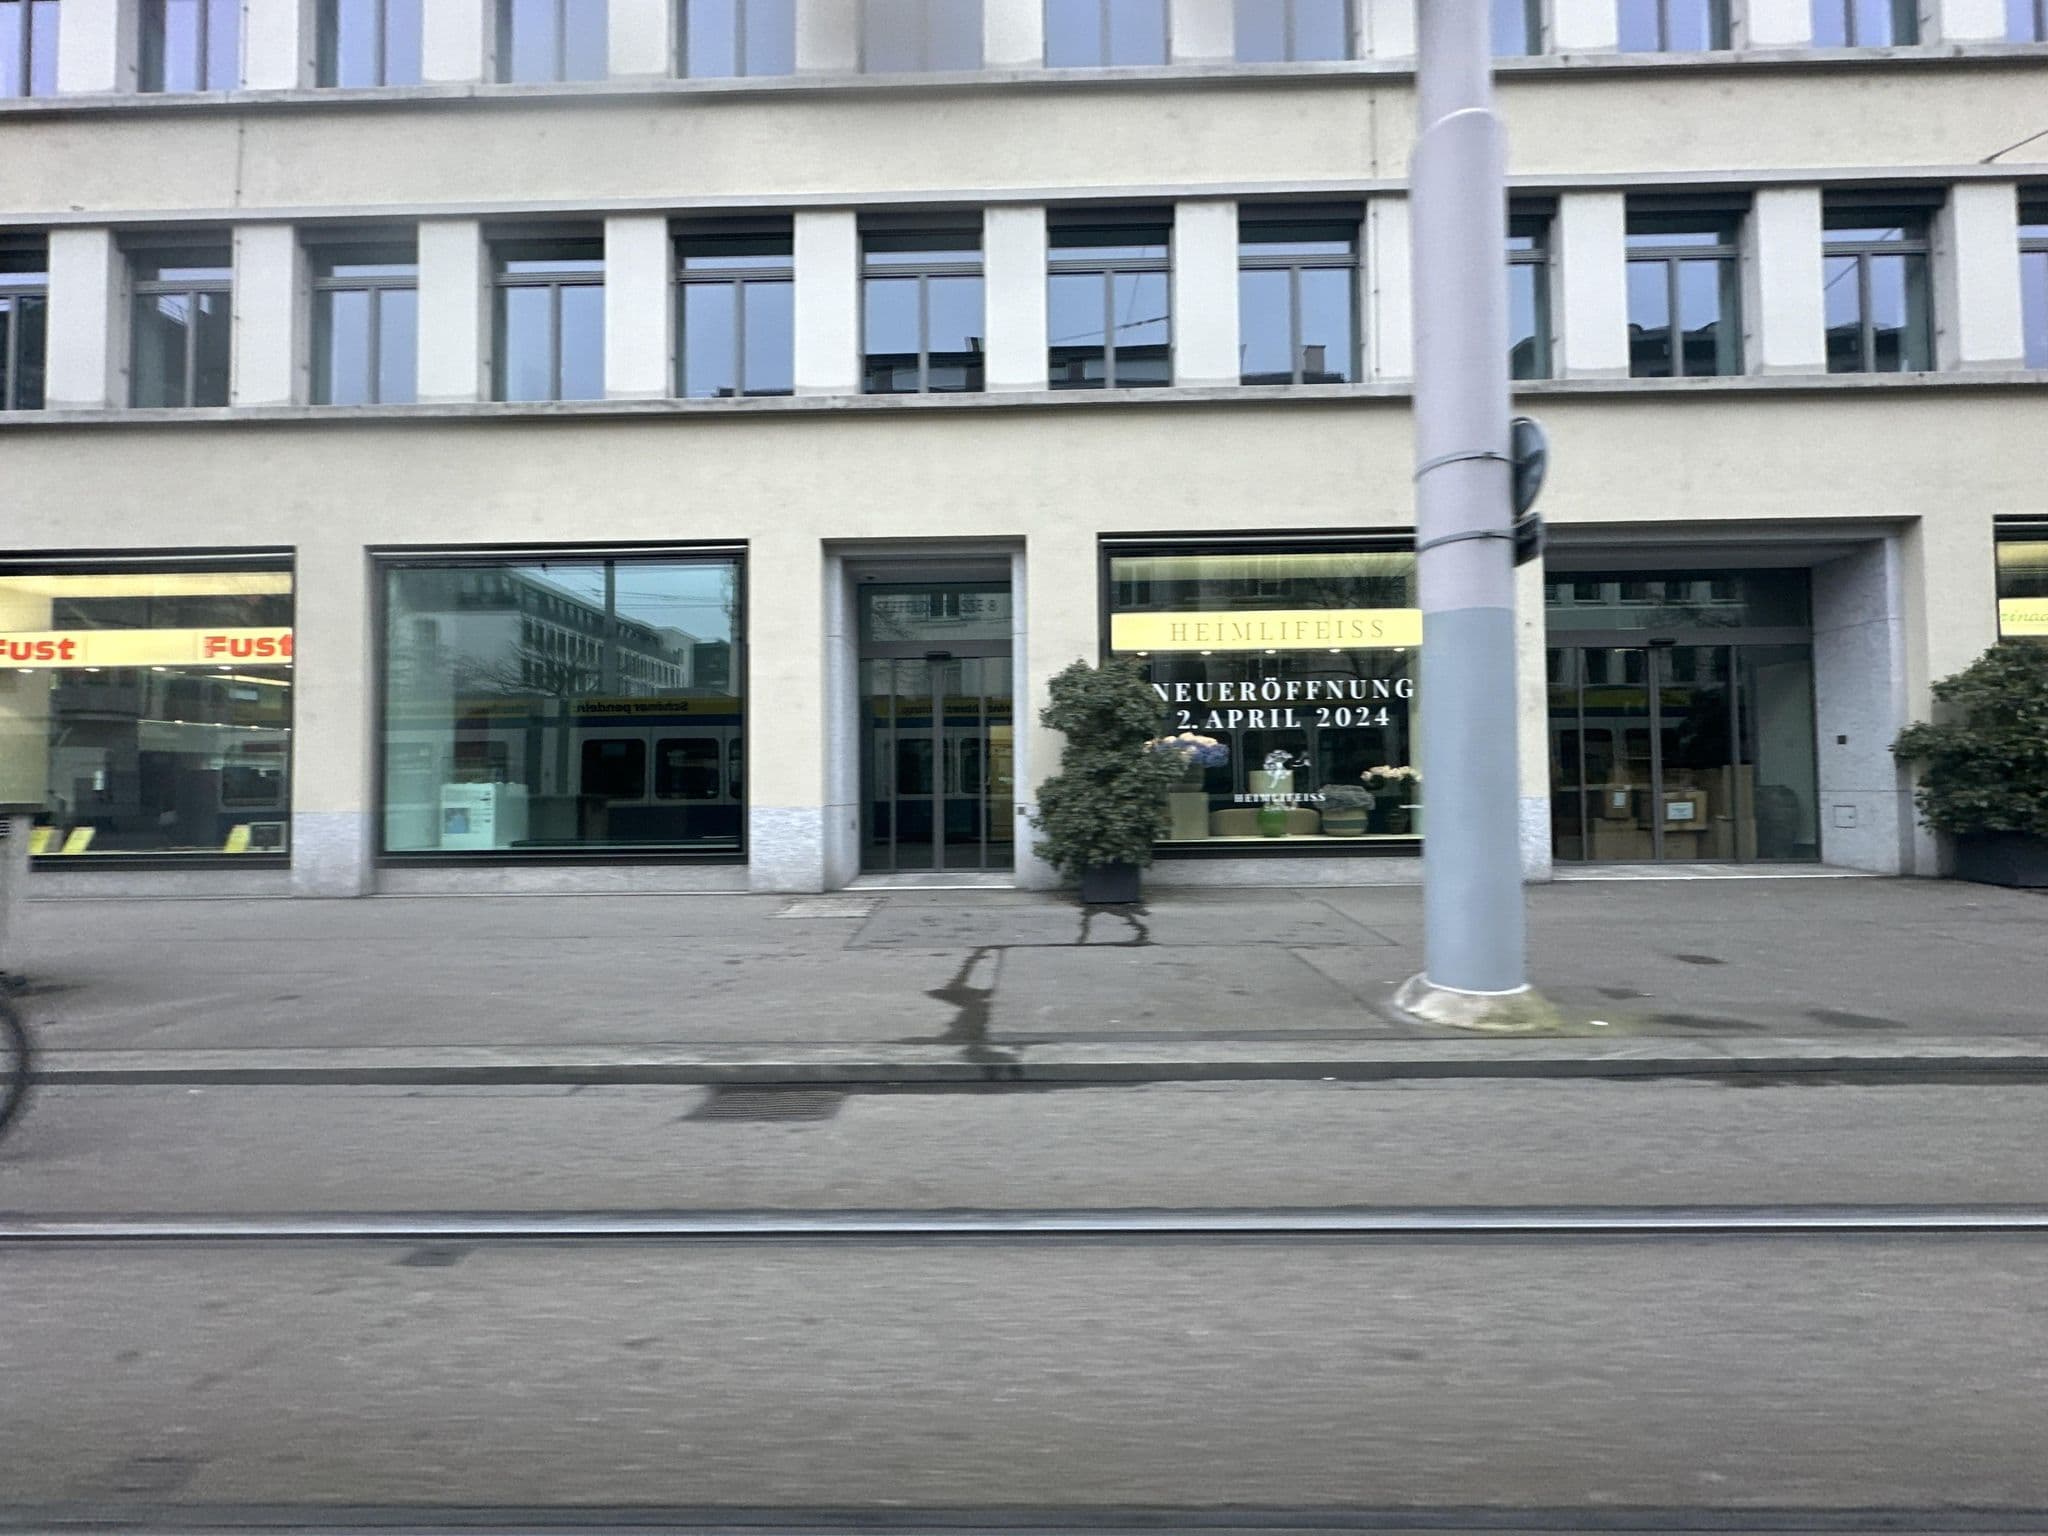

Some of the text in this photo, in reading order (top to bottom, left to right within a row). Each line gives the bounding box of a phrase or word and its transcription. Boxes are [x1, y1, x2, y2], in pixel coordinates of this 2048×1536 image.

[1170, 619, 1384, 642] HEIMLIFEISS
[205, 634, 293, 658] Fust
[1152, 677, 1414, 702] NEUERÖFFNUNG
[1176, 706, 1390, 729] 2. APRIL 2024
